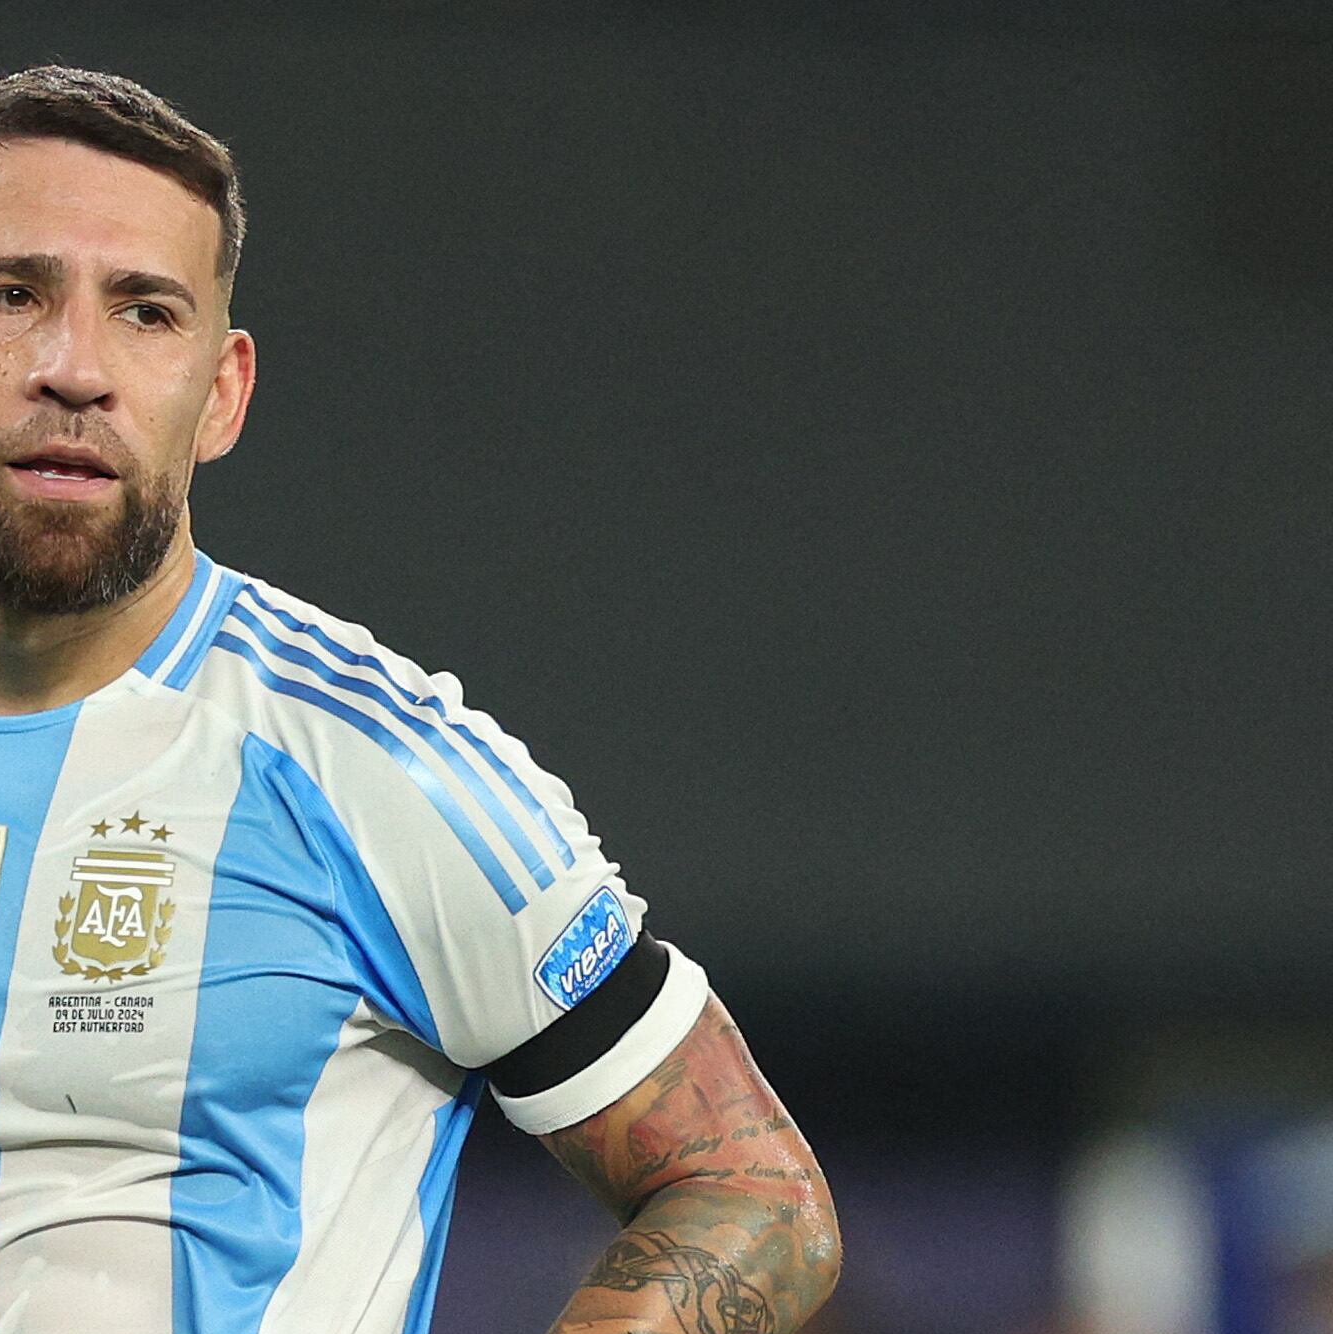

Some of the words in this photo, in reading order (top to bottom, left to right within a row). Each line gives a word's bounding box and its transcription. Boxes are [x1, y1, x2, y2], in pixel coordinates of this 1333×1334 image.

[78, 884, 146, 947] AFA
[561, 914, 620, 993] VIBRA
[48, 996, 102, 1007] ARGENTINA
[114, 996, 154, 1007] CANADA
[55, 1009, 68, 1020] 09
[71, 1009, 84, 1020] DE
[87, 1009, 114, 1020] JULIO
[117, 1009, 144, 1020] 2024
[53, 1021, 77, 1033] EAST
[80, 1021, 144, 1033] RUTHERFORD
